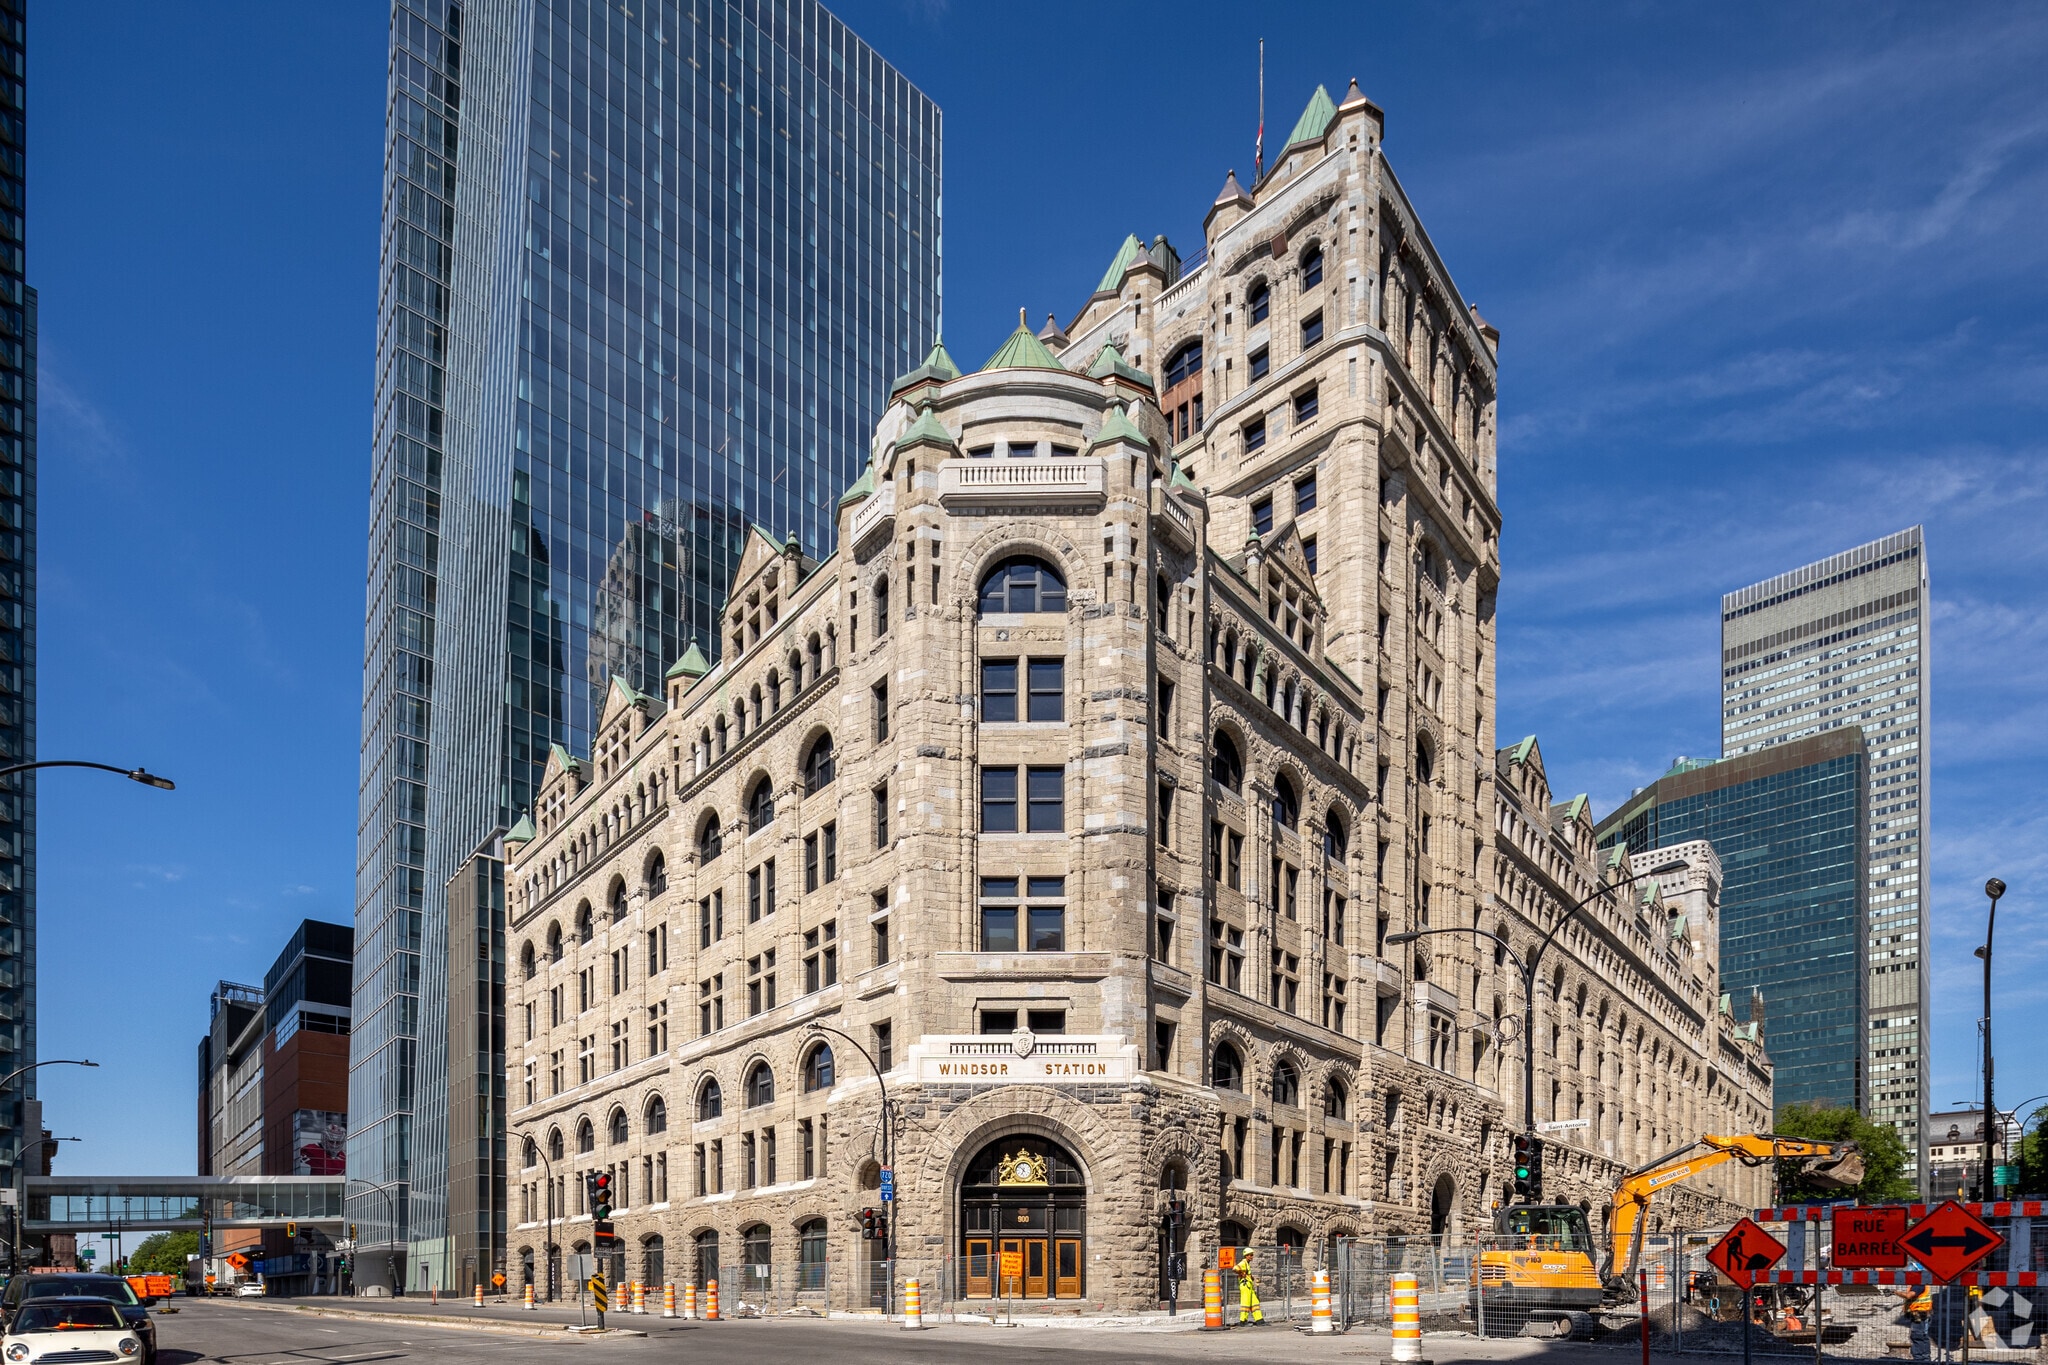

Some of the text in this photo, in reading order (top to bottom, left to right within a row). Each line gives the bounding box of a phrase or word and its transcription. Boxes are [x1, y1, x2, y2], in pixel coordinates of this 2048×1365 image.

[939, 1063, 1106, 1075] WINDSOR STATION
[881, 1171, 892, 1179] 720
[1017, 1215, 1030, 1223] 900
[1853, 1219, 1885, 1233] RUE
[1837, 1238, 1902, 1256] BARRÉE
